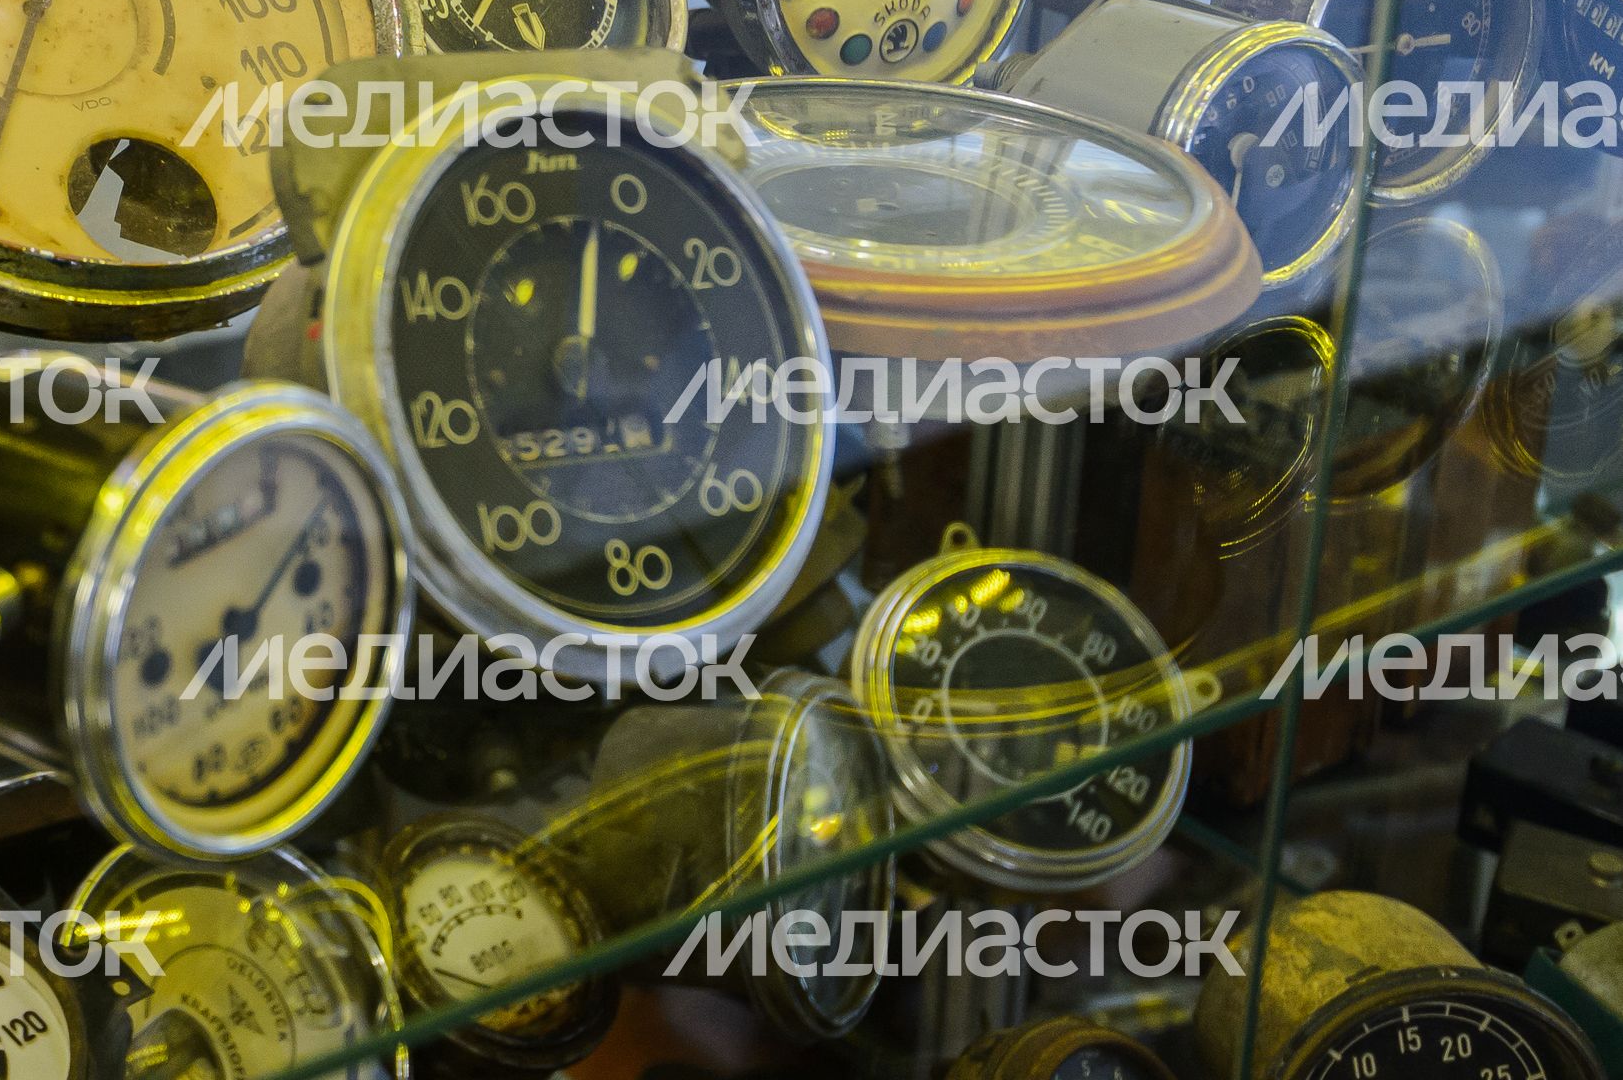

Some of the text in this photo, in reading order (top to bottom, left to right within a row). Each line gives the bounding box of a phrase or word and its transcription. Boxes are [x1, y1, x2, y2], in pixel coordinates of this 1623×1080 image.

[239, 40, 309, 87] 110
[72, 95, 113, 113] VDO
[461, 174, 537, 227] 160
[609, 172, 648, 215] 0
[684, 236, 743, 291] 20
[400, 268, 475, 323] 140
[723, 354, 781, 407] 40
[411, 390, 480, 449] 120
[697, 462, 764, 518] 60
[477, 500, 563, 554] 100
[603, 537, 674, 597] 80
[1, 1009, 50, 1049] 120
[1397, 1026, 1422, 1055] 15
[1440, 1032, 1473, 1063] 20
[1351, 1052, 1378, 1080] 10
